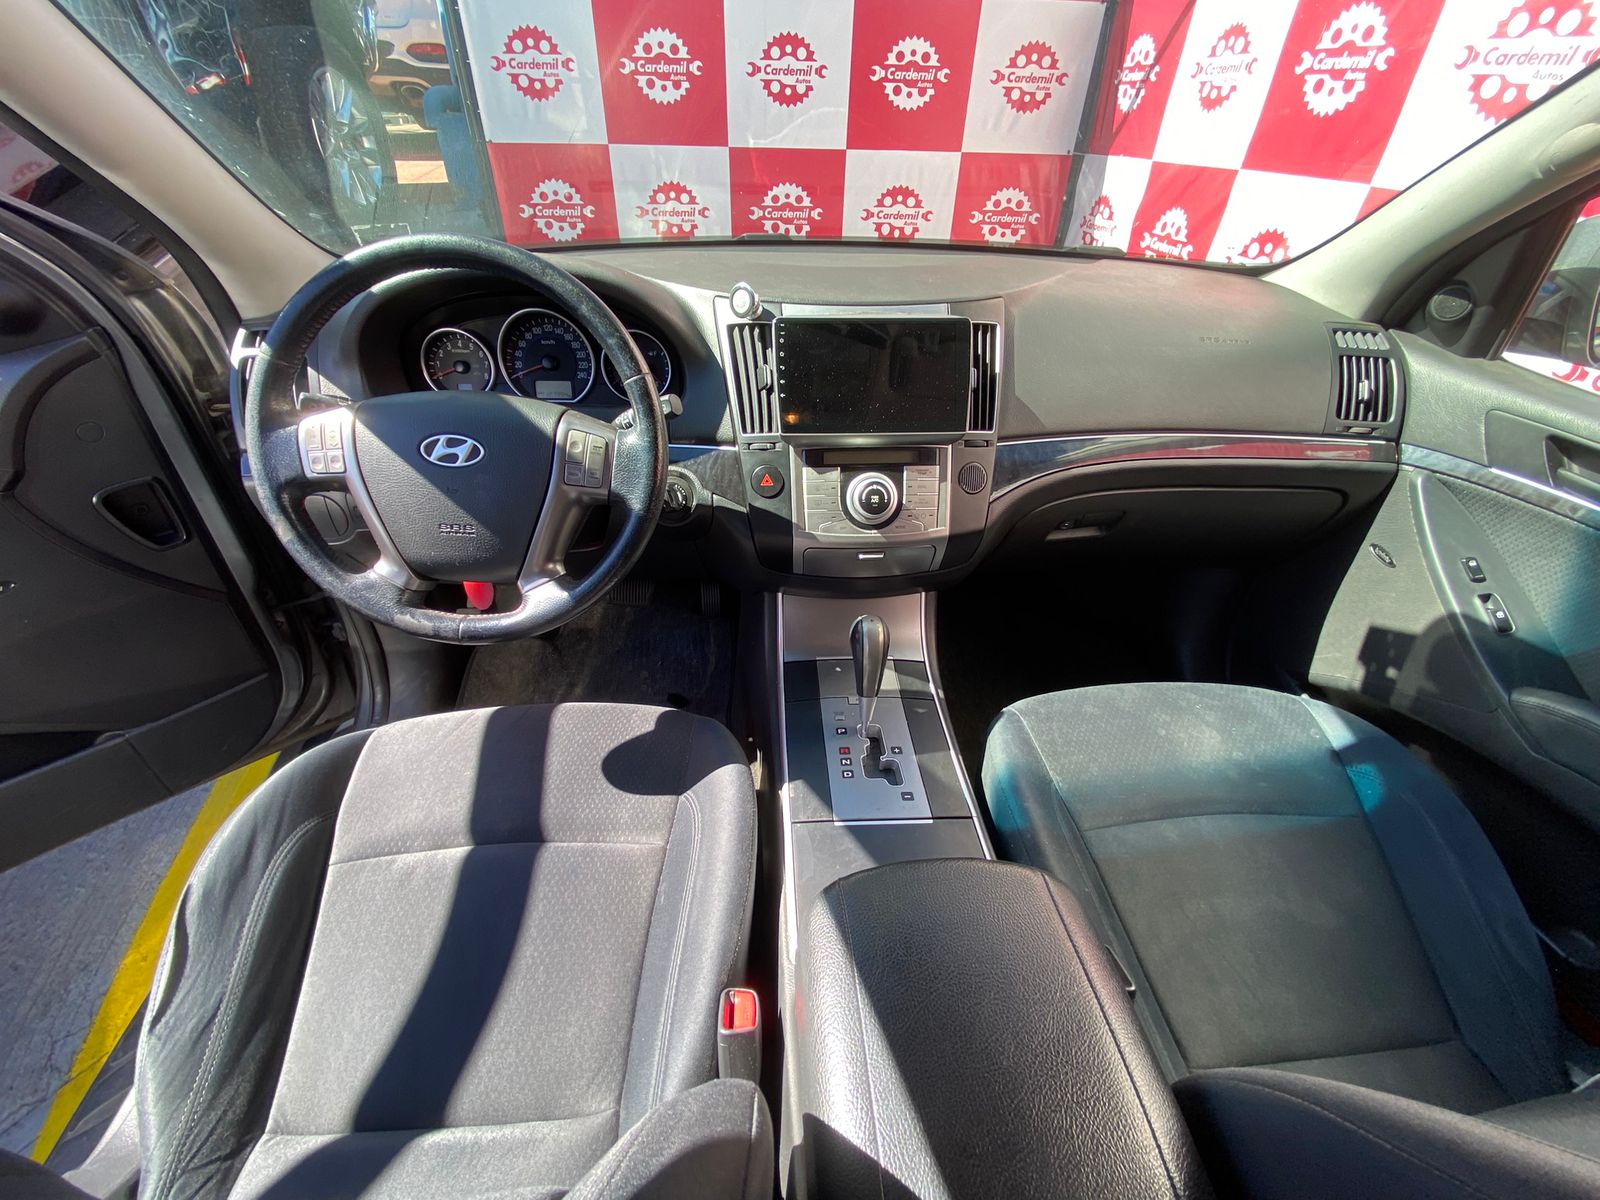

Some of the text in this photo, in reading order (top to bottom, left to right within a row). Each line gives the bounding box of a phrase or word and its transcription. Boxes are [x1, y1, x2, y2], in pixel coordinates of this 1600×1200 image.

[1313, 49, 1377, 70] Cardemil
[1483, 45, 1581, 66] Cardemil
[508, 56, 559, 70] Cardemil
[637, 60, 687, 73] Cardemil
[764, 64, 813, 77] Cardemil
[887, 67, 936, 81] Cardemil
[1532, 69, 1564, 81] Autos
[670, 73, 687, 81] Autos
[1007, 72, 1055, 84] Cardemil
[535, 205, 581, 216] Cardemil
[651, 207, 696, 217] Cardemil
[764, 207, 809, 219] Cardemil
[876, 210, 920, 220] Cardemil
[984, 213, 1028, 223] Cardemil
[578, 361, 588, 369] 220
